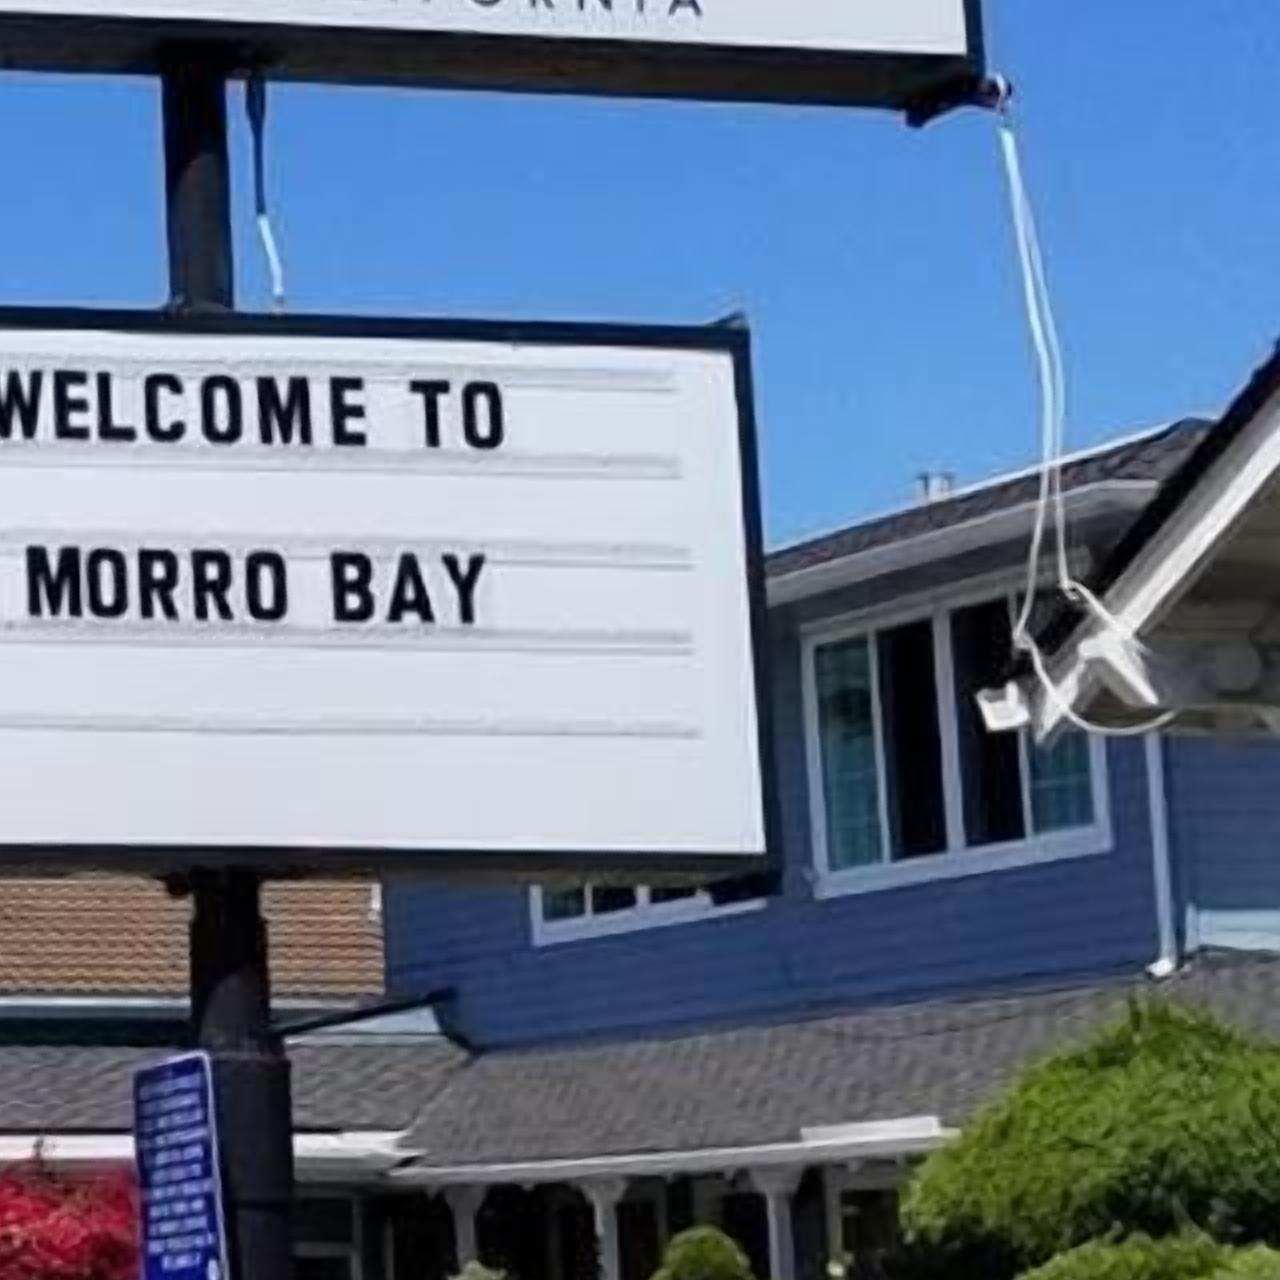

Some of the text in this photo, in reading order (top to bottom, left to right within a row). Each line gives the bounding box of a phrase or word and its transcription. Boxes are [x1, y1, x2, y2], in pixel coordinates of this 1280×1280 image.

[409, 379, 503, 450] TO
[26, 545, 485, 624] MORRO BAY
